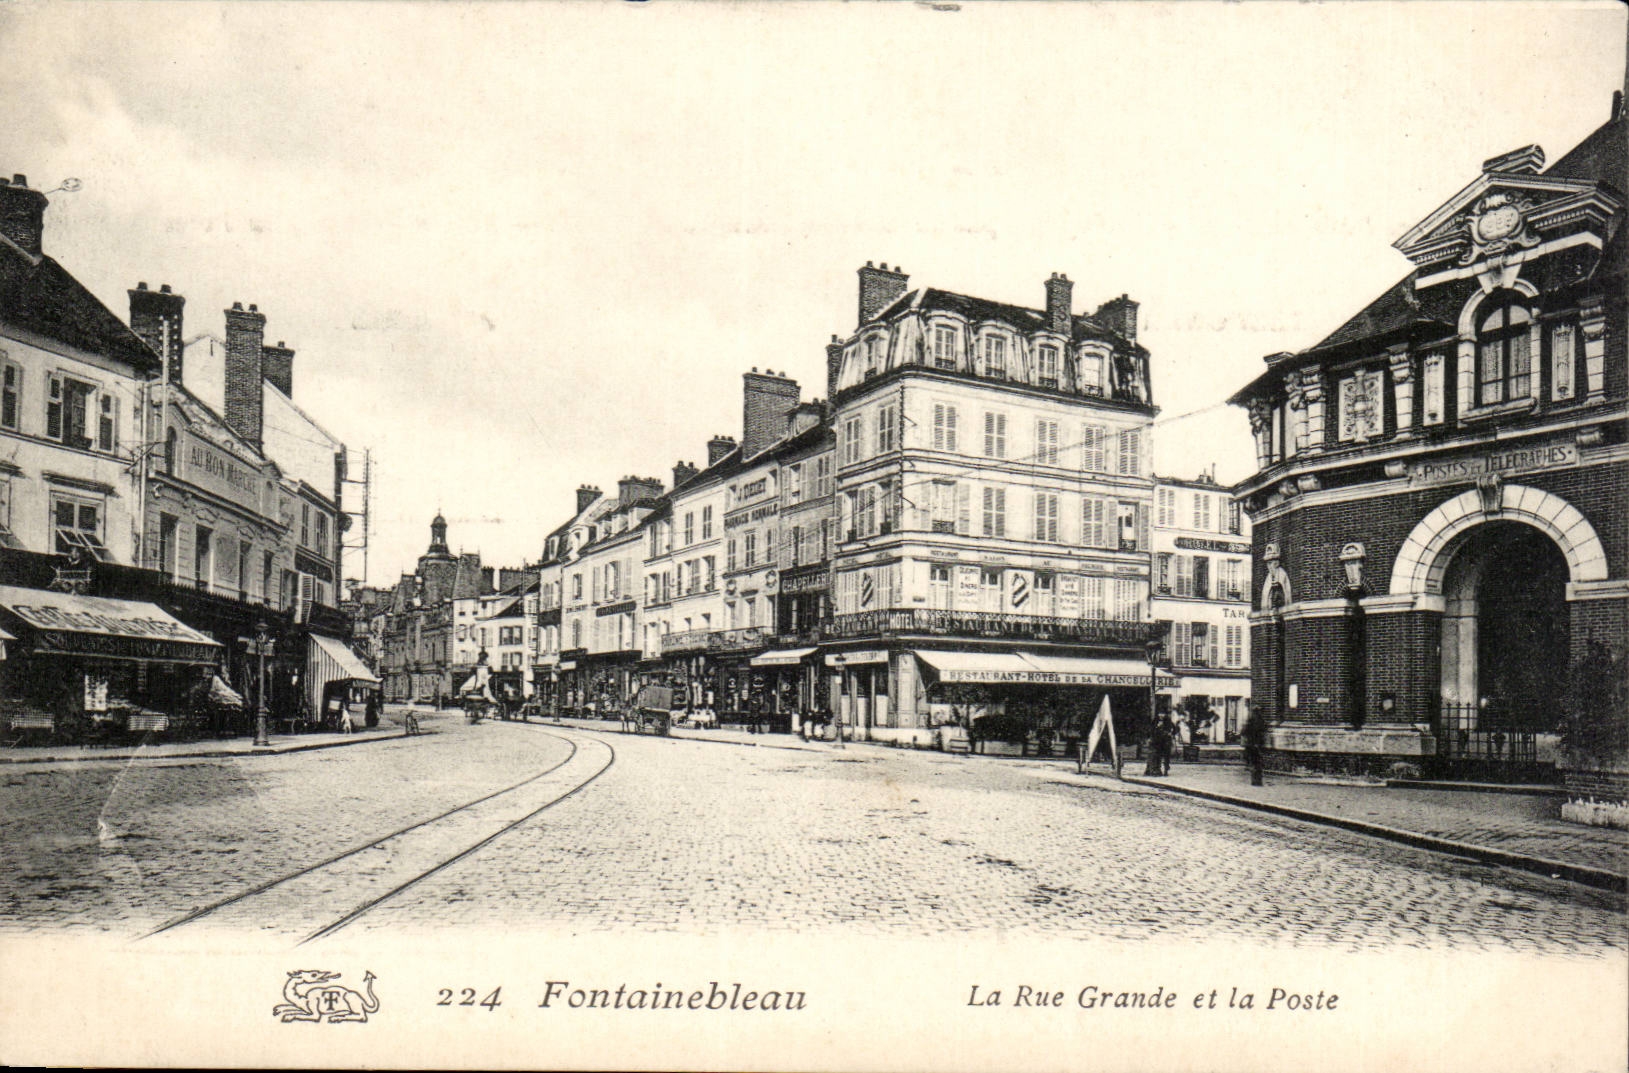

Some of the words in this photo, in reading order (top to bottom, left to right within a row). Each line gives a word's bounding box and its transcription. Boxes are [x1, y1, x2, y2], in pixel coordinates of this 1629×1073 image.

[190, 446, 203, 468] AU
[205, 450, 225, 479] BON
[1424, 461, 1468, 479] POSTES
[934, 616, 1015, 632] RESTAURANT
[1065, 675, 1077, 683] DE
[1081, 675, 1092, 683] LA
[1096, 673, 1176, 686] CHANCELLRIE
